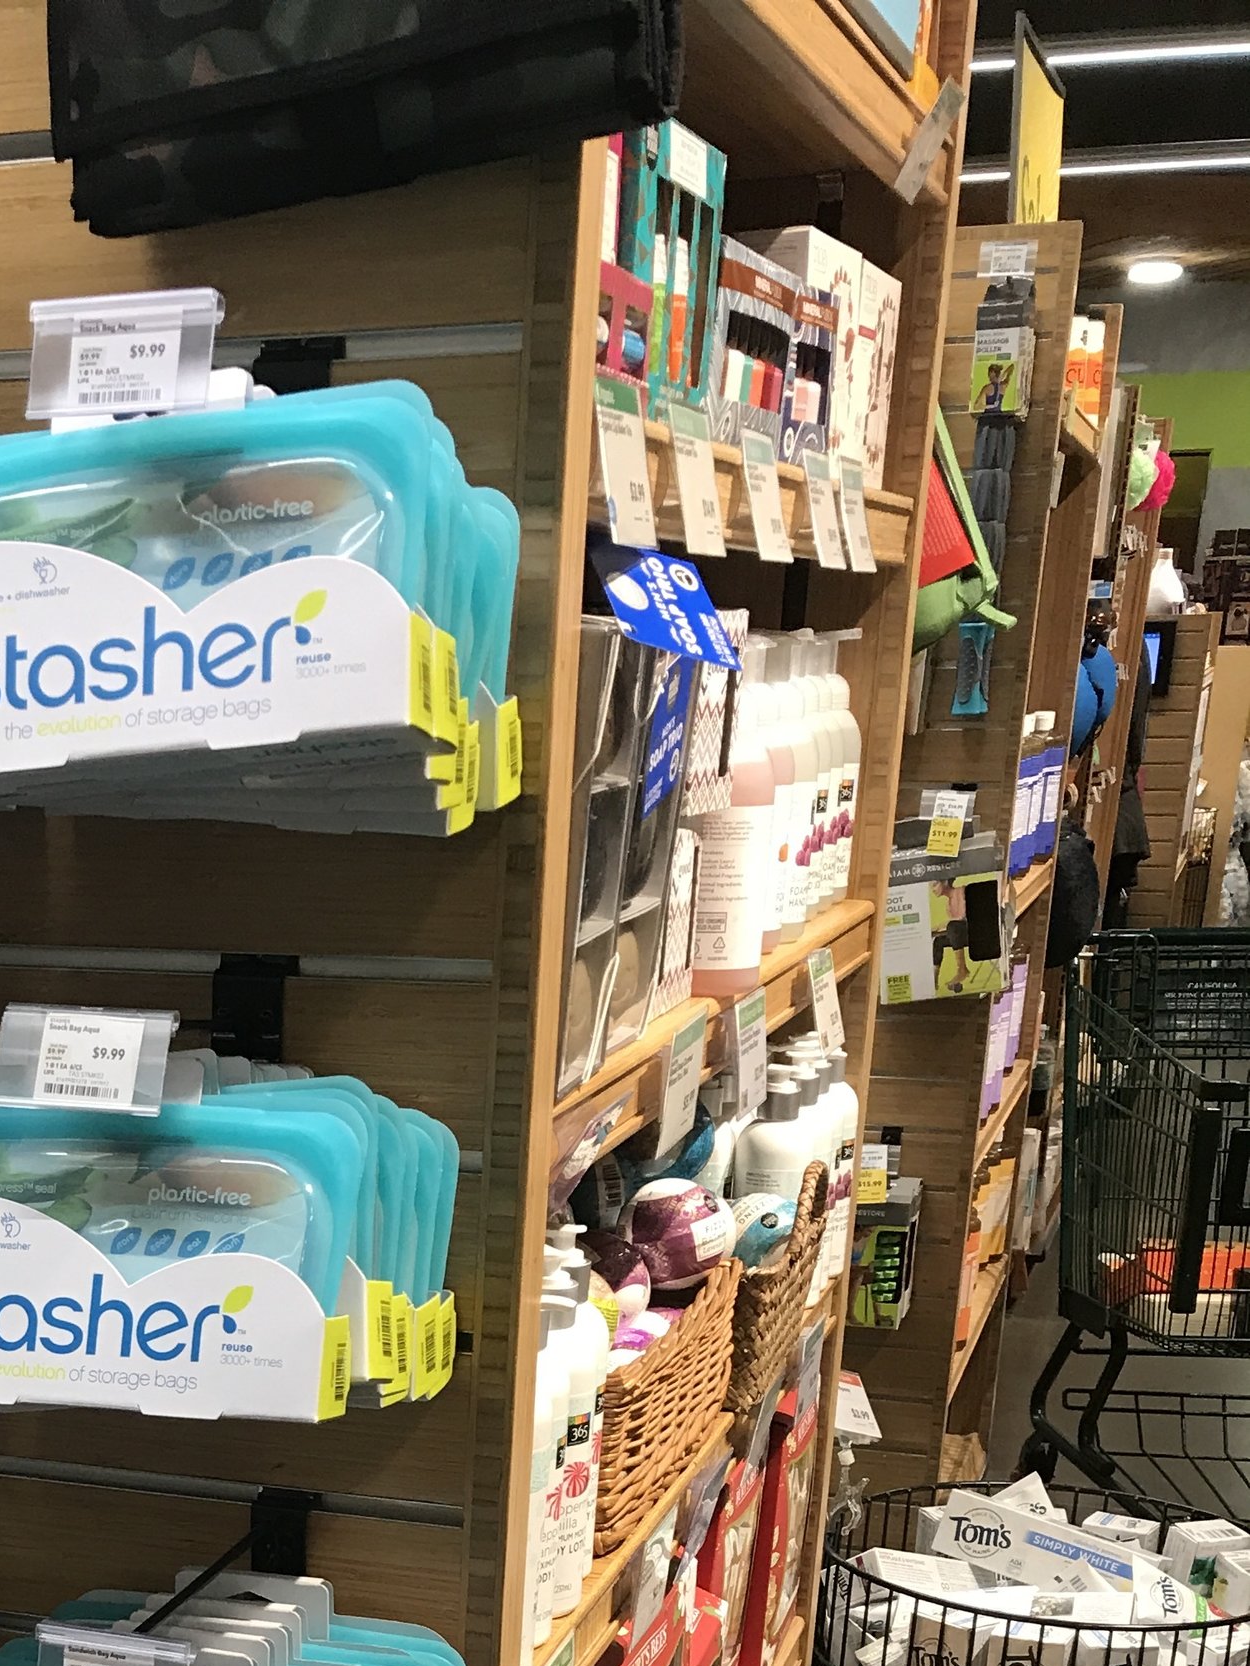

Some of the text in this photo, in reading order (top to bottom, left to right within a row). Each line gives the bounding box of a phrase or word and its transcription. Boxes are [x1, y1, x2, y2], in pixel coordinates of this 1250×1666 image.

[129, 341, 166, 360] $9.99
[198, 499, 315, 529] plastic-free
[15, 586, 71, 602] dishwasher
[646, 556, 703, 656] SOAP TRIO
[295, 652, 332, 665] reuse
[4, 696, 273, 741] the evolution of storage bags
[887, 975, 910, 985] FREE
[83, 1026, 100, 1035] Aqua
[92, 1046, 126, 1061] $9.99
[149, 1187, 253, 1208] plastic-free
[221, 1342, 253, 1354] reuse
[68, 1365, 86, 1384] of
[87, 1369, 151, 1393] storage
[153, 1372, 199, 1395] bags
[570, 1425, 590, 1442] 365
[949, 1514, 1013, 1549] Tom's
[1032, 1534, 1120, 1574] SIMPLY WHITE
[1160, 1575, 1179, 1619] Tom's
[649, 1626, 669, 1659] BEES
